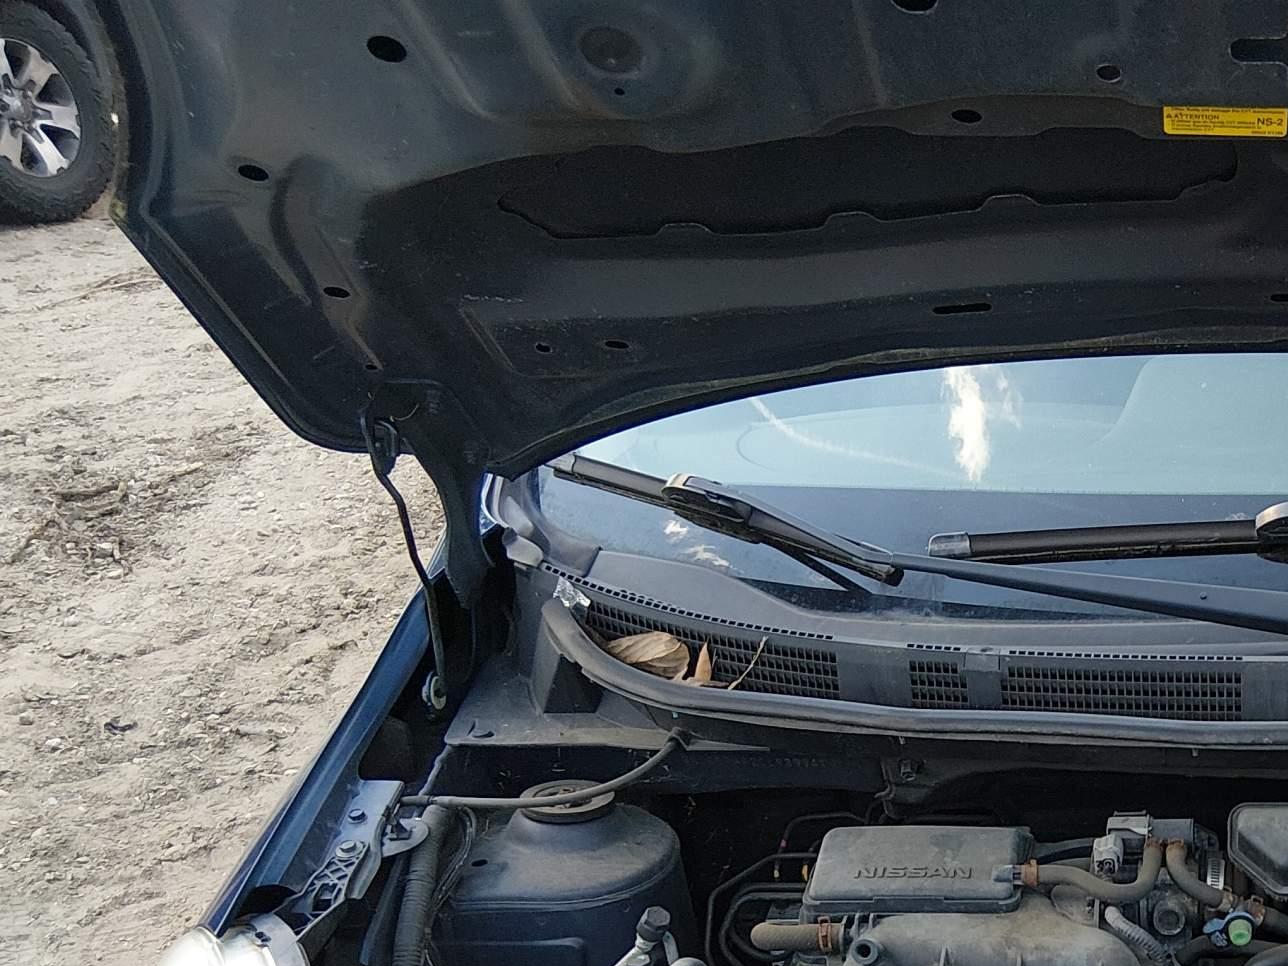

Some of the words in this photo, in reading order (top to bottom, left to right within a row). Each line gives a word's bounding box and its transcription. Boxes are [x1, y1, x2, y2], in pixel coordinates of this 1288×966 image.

[1174, 112, 1220, 121] ATTENTION
[1257, 117, 1284, 127] NS-2
[853, 866, 973, 880] NISSAN
